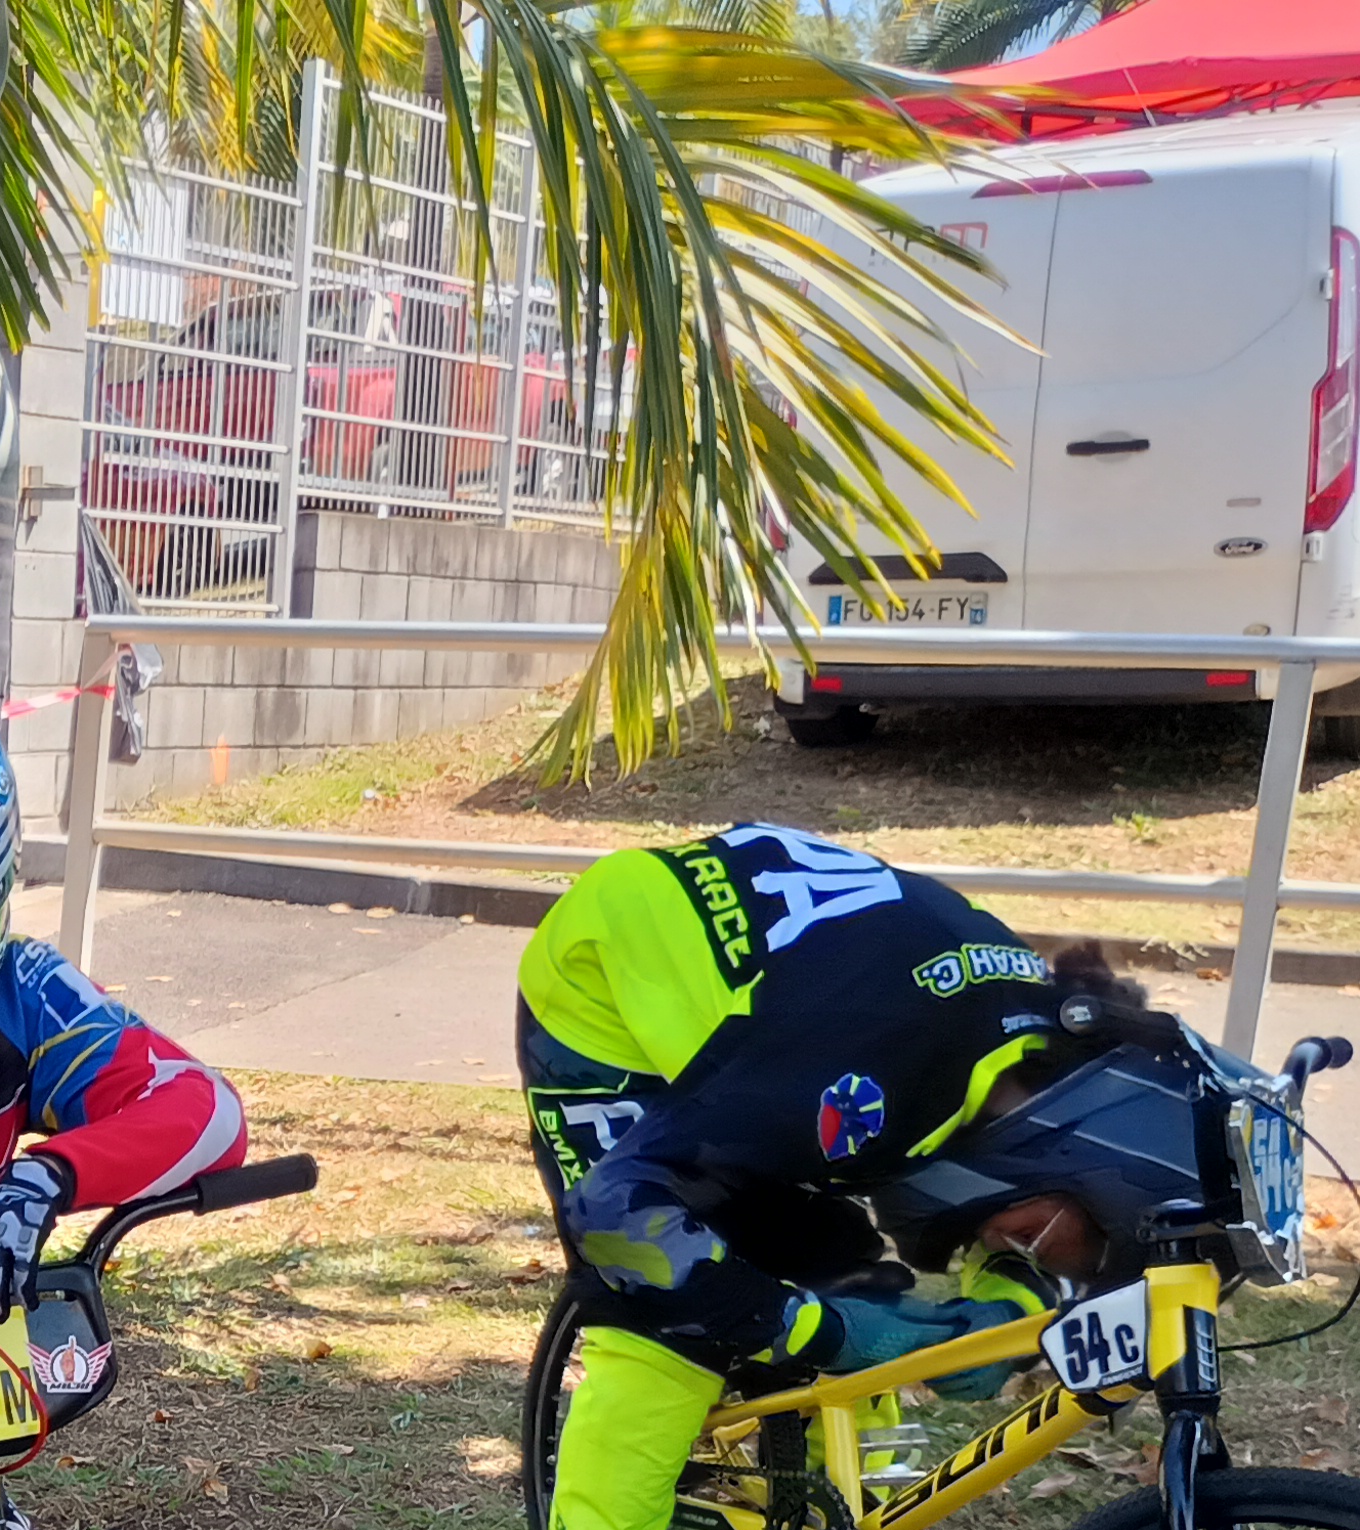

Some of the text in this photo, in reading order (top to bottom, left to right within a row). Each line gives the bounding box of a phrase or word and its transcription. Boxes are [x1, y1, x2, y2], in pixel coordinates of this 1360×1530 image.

[684, 855, 751, 969] RACE
[538, 1110, 585, 1183] BMX
[1061, 1311, 1140, 1385] 54 C
[0, 1365, 39, 1426] M
